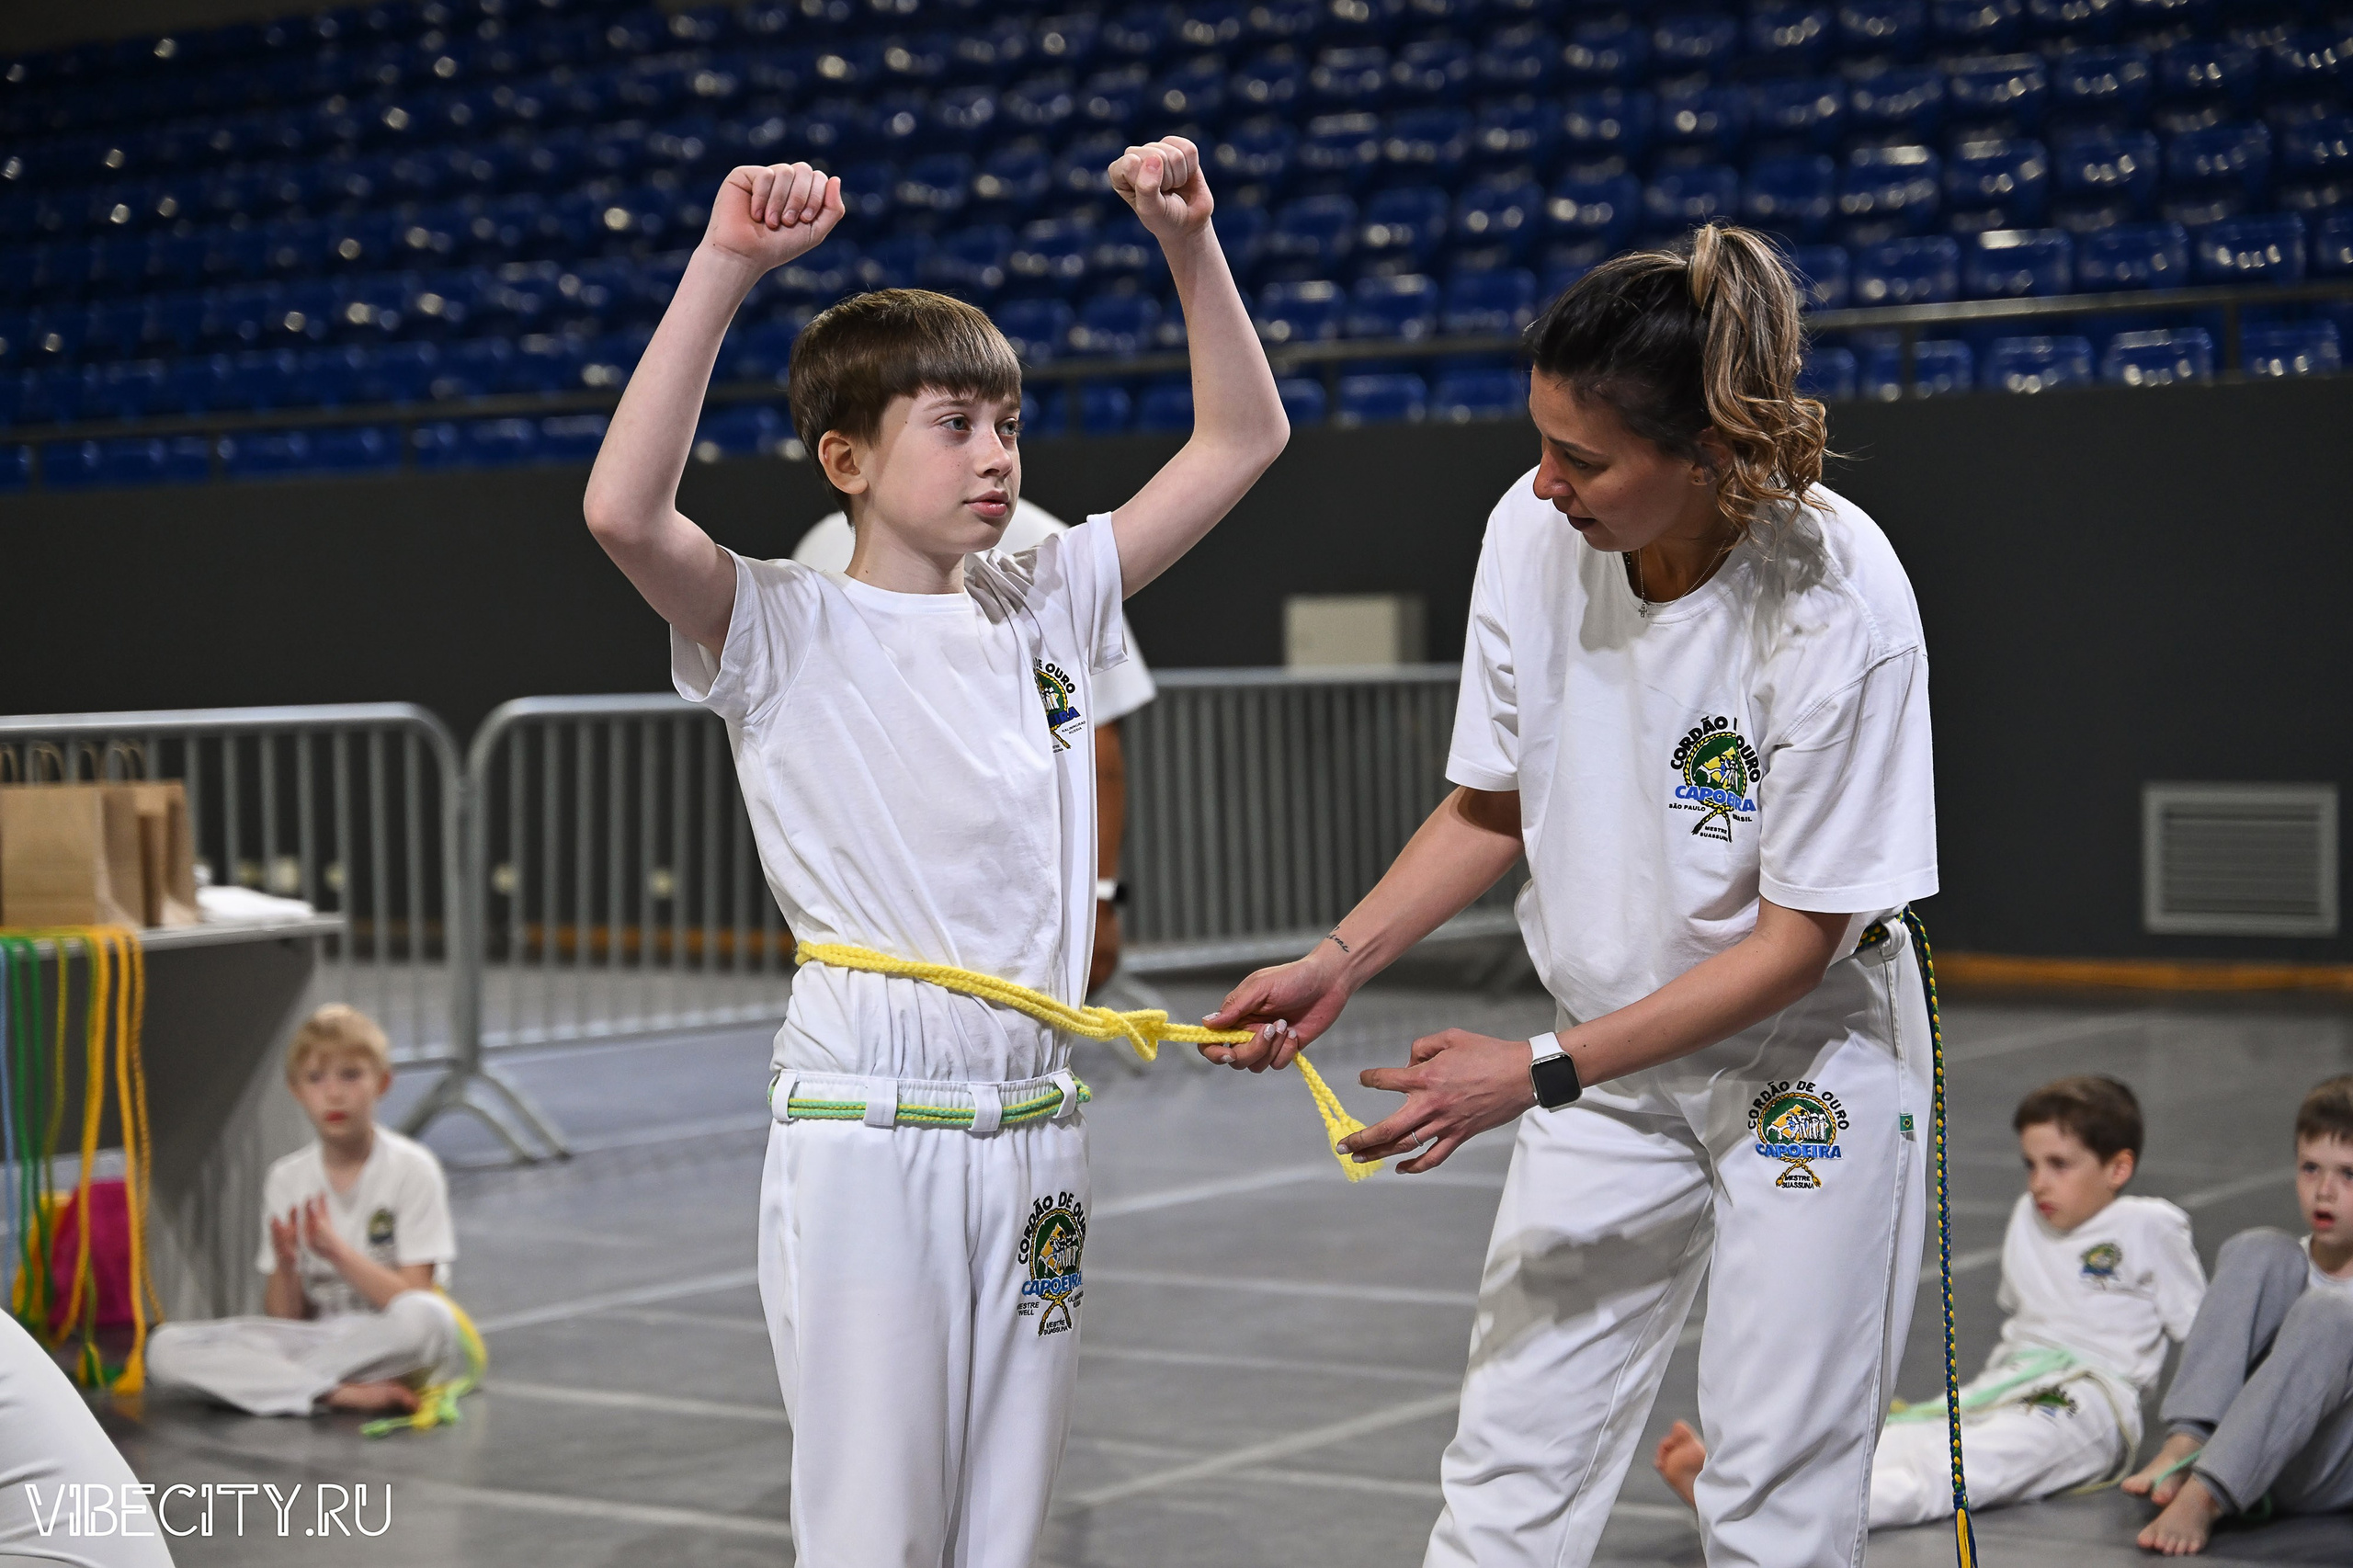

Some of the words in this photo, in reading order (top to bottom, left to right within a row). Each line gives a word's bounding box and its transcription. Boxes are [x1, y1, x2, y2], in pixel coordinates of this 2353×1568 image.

[1045, 663, 1075, 694] OURO
[1670, 715, 1728, 770] CORDÃO
[1735, 735, 1761, 783] OURO
[1704, 825, 1727, 835] MESTRE
[1747, 1080, 1790, 1131] CORDÃO
[1796, 1080, 1816, 1093] DE
[1821, 1091, 1850, 1131] OURO
[1756, 1142, 1843, 1159] CAPOEIRA
[1018, 1195, 1053, 1265] CORDÃO
[1058, 1191, 1074, 1210] DE
[1074, 1202, 1086, 1241] OUR
[1021, 1272, 1083, 1297] CAPOEIRA
